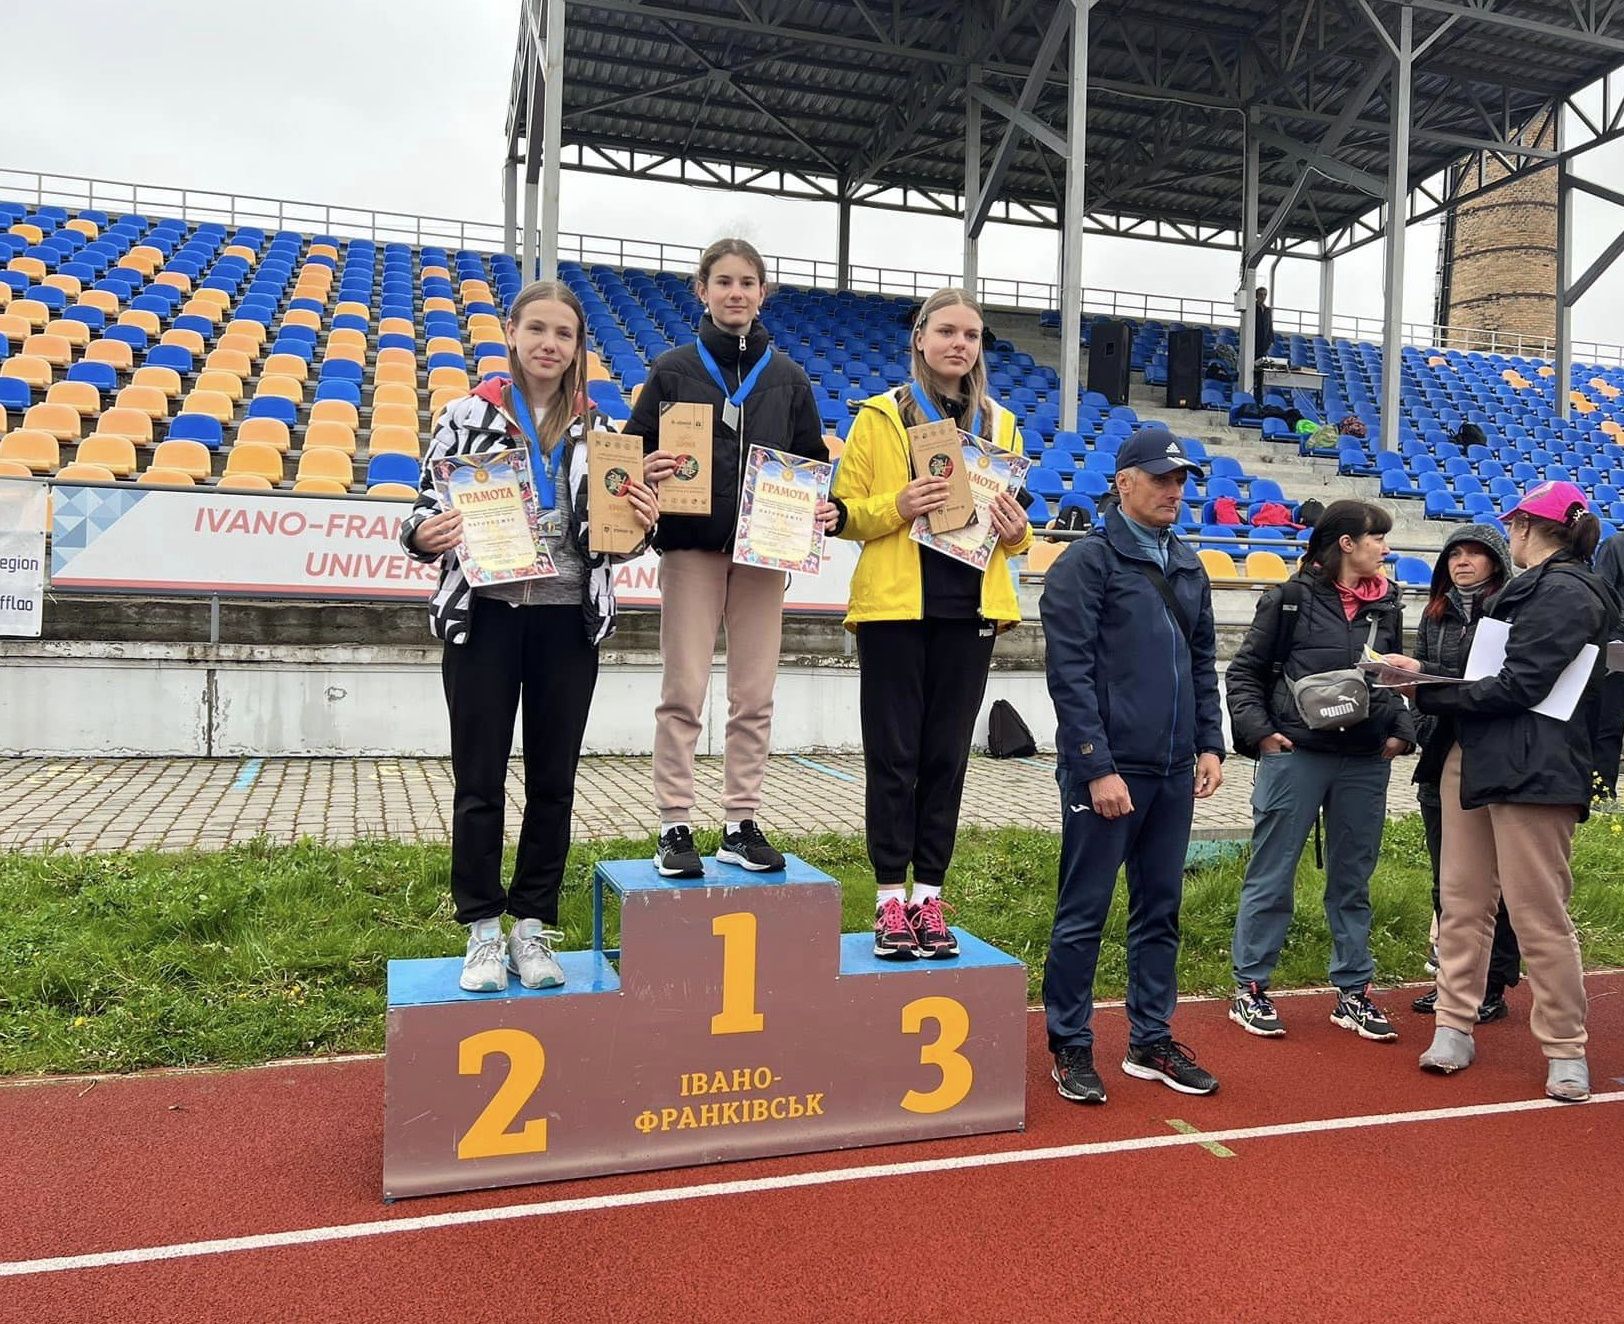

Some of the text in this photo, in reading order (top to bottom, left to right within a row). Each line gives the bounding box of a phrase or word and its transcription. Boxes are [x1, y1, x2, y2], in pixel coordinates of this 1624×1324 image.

[458, 487, 515, 505] ГРАМОТА
[762, 482, 810, 501] ГРАМОТА
[1320, 702, 1355, 718] PUMA
[711, 911, 764, 1036] 1
[900, 996, 975, 1114] 3
[457, 1028, 547, 1160] 2
[680, 1067, 782, 1096] ІВАНО-
[634, 1093, 825, 1133] ФРАНКІВСЬК
